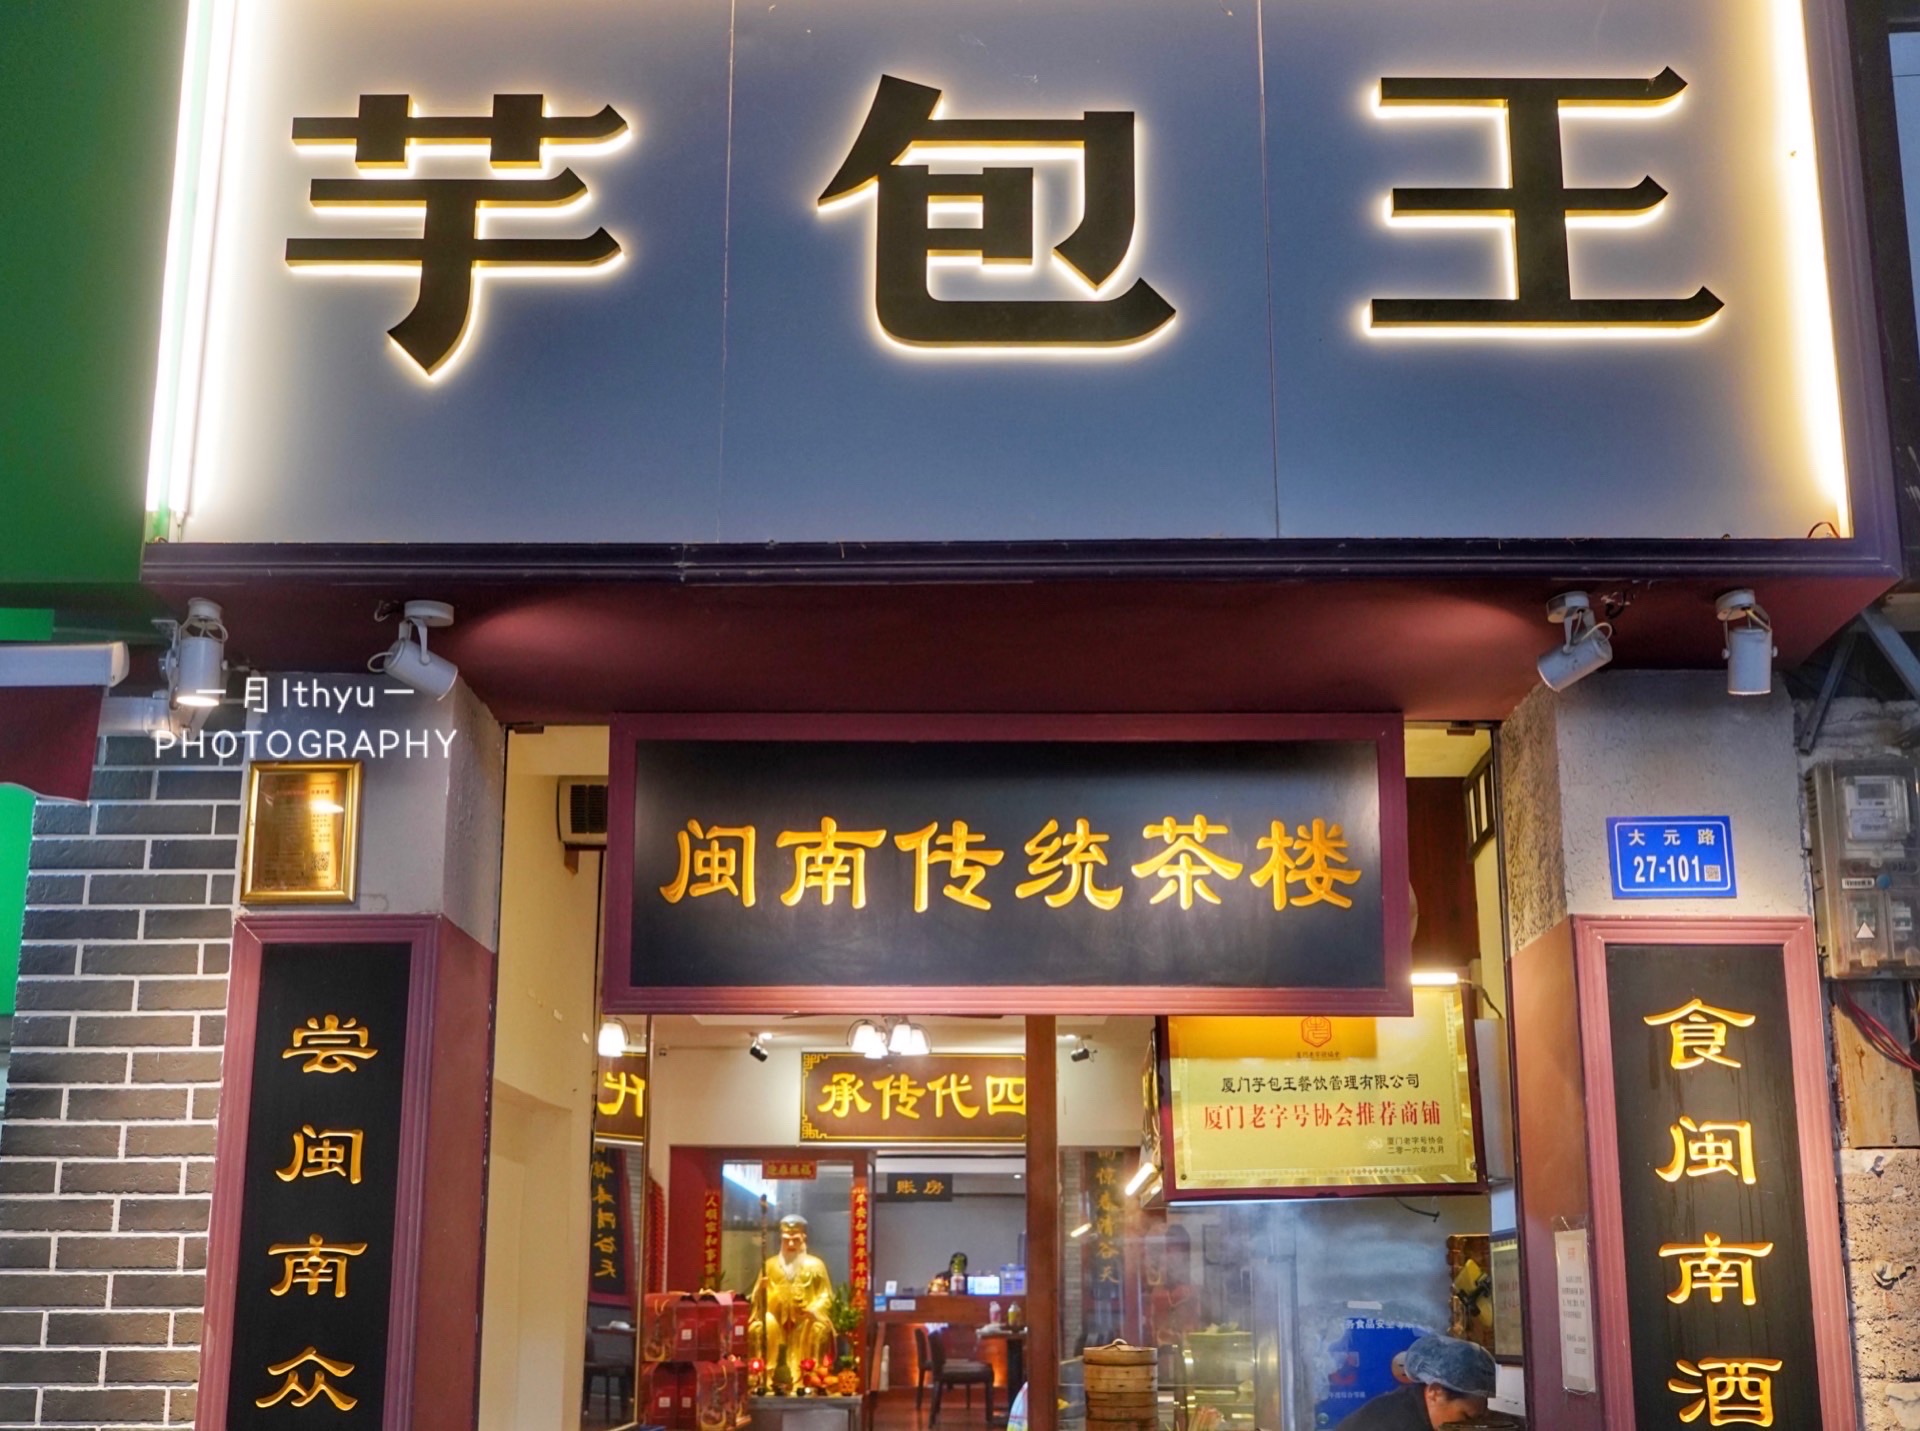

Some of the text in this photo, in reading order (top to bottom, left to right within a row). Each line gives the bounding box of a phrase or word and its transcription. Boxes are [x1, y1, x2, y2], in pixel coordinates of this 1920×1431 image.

[285, 67, 1725, 380] 芋包王
[1628, 828, 1715, 846] 大元路
[660, 814, 1362, 914] 闽南传统茶楼
[1634, 855, 1700, 883] 27-101
[1221, 1073, 1420, 1094] 厦门芋包王餐饮管理有限公司
[1205, 1100, 1441, 1130] 厦门老字号协会推荐商铺
[1387, 1136, 1444, 1146] 厦门老字号协会
[1387, 1146, 1445, 1155] 二零一六年九月
[255, 1014, 378, 1411] 尝闽南众
[1643, 998, 1783, 1428] 食闽南酒
